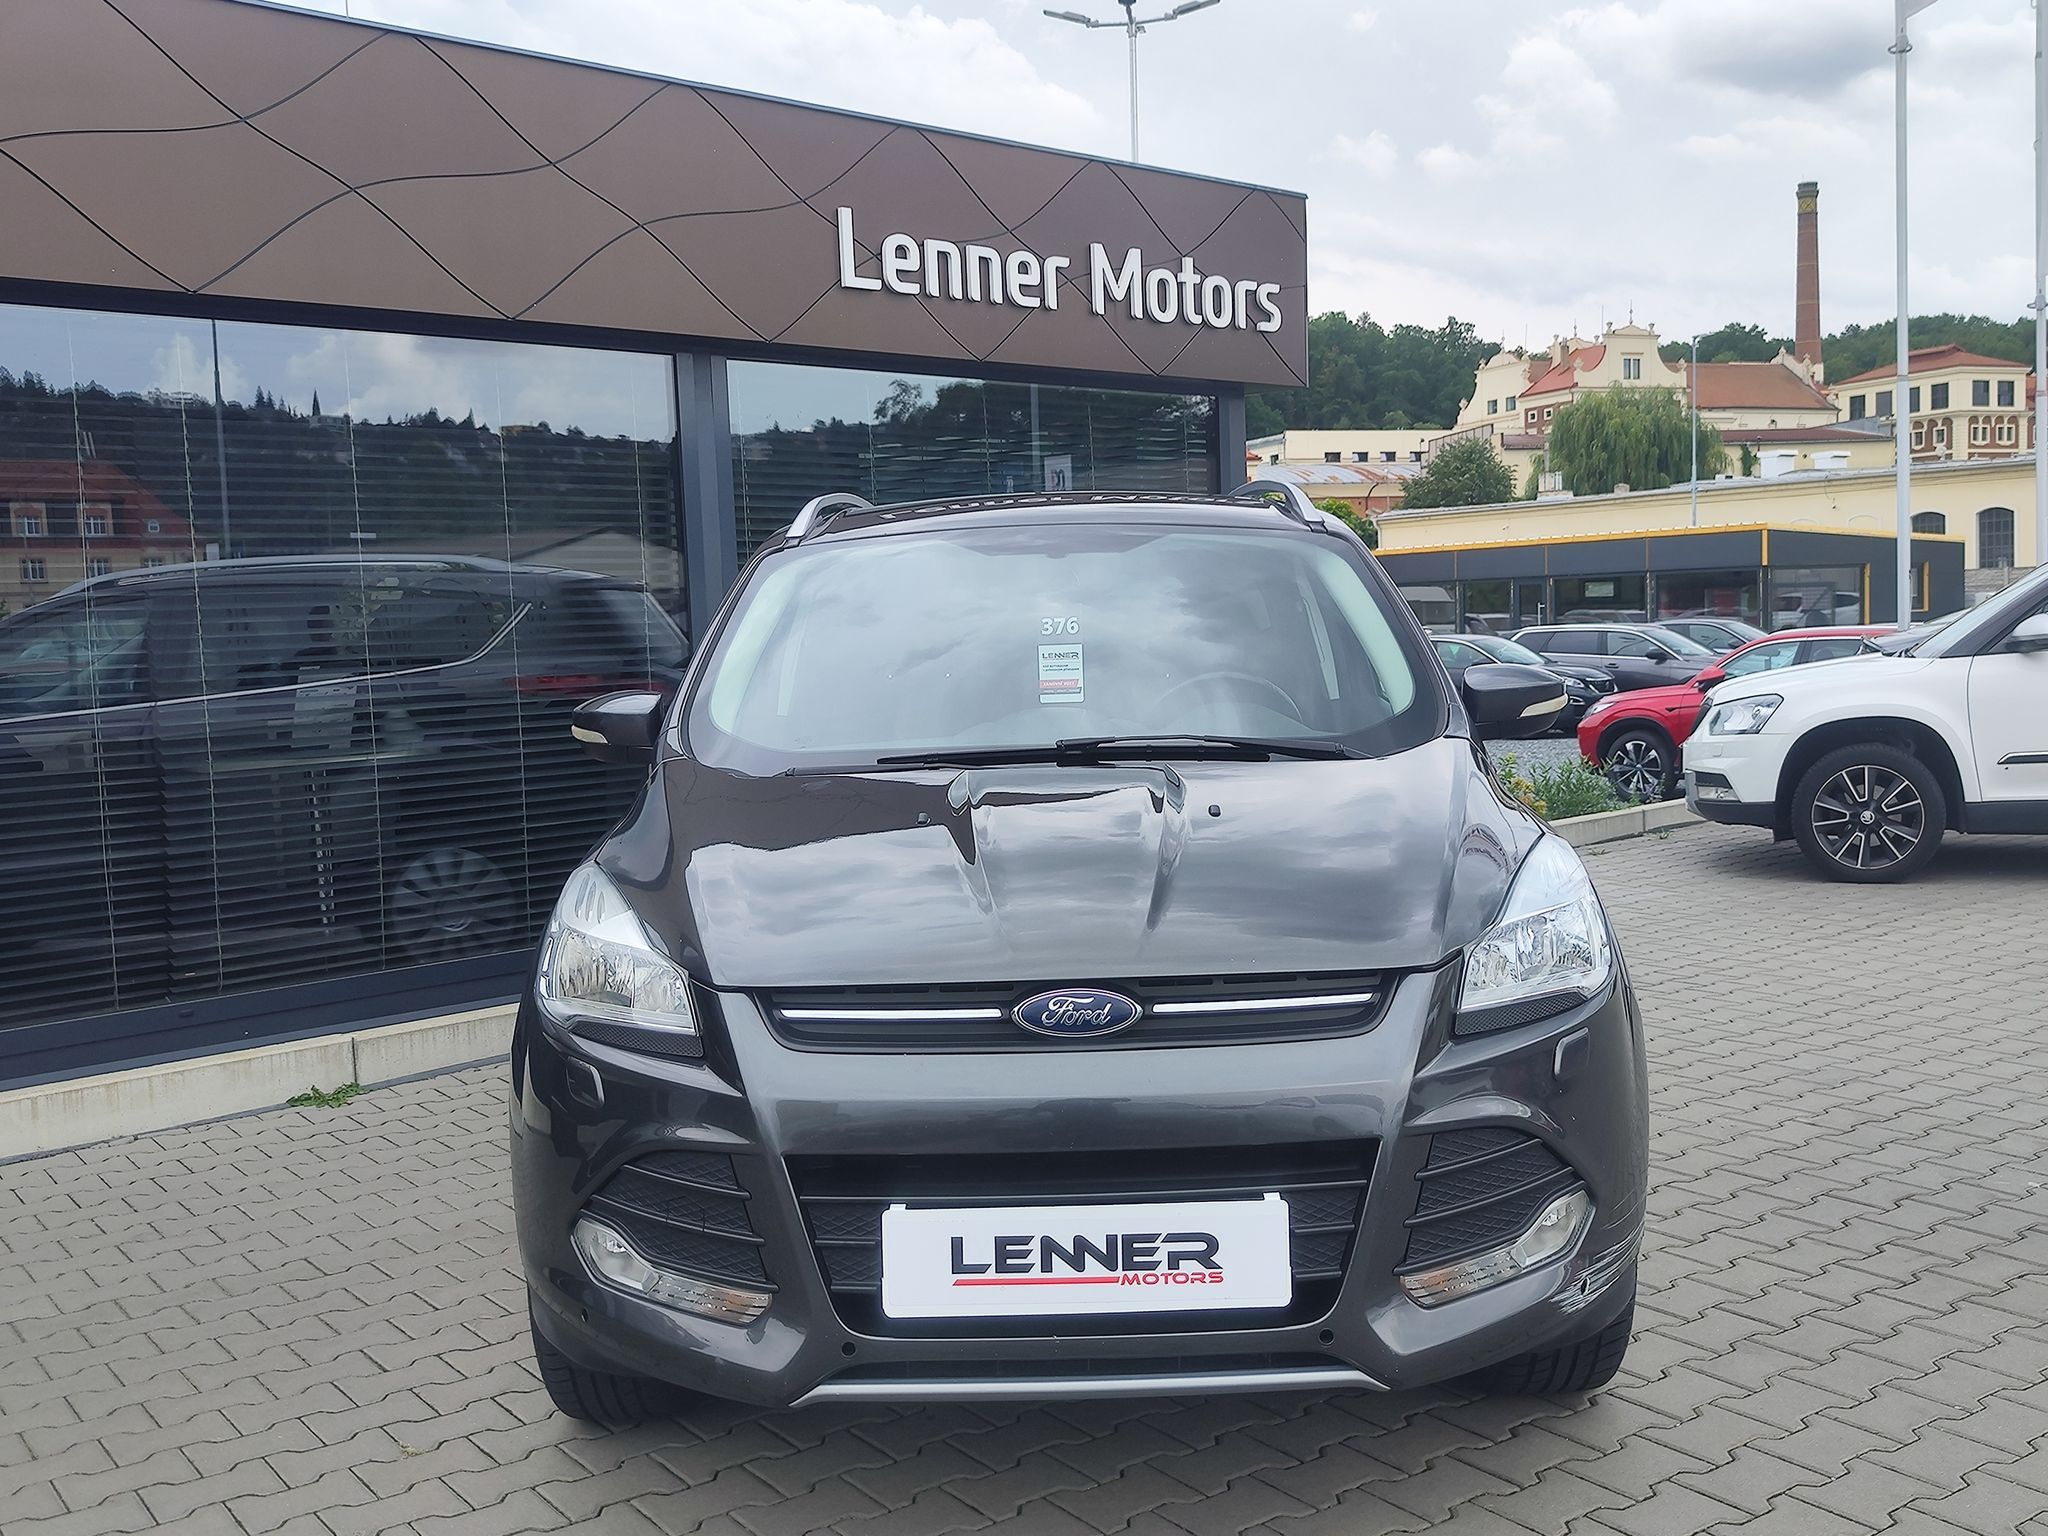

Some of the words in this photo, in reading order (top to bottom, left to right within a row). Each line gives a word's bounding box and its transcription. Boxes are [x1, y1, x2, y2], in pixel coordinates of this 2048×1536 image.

[837, 206, 1070, 310] Lenner
[1089, 242, 1282, 333] Motors
[1040, 616, 1080, 635] 376
[1041, 996, 1113, 1026] Ford
[951, 1232, 1224, 1274] LENNER
[1120, 1271, 1224, 1286] MOTORS
